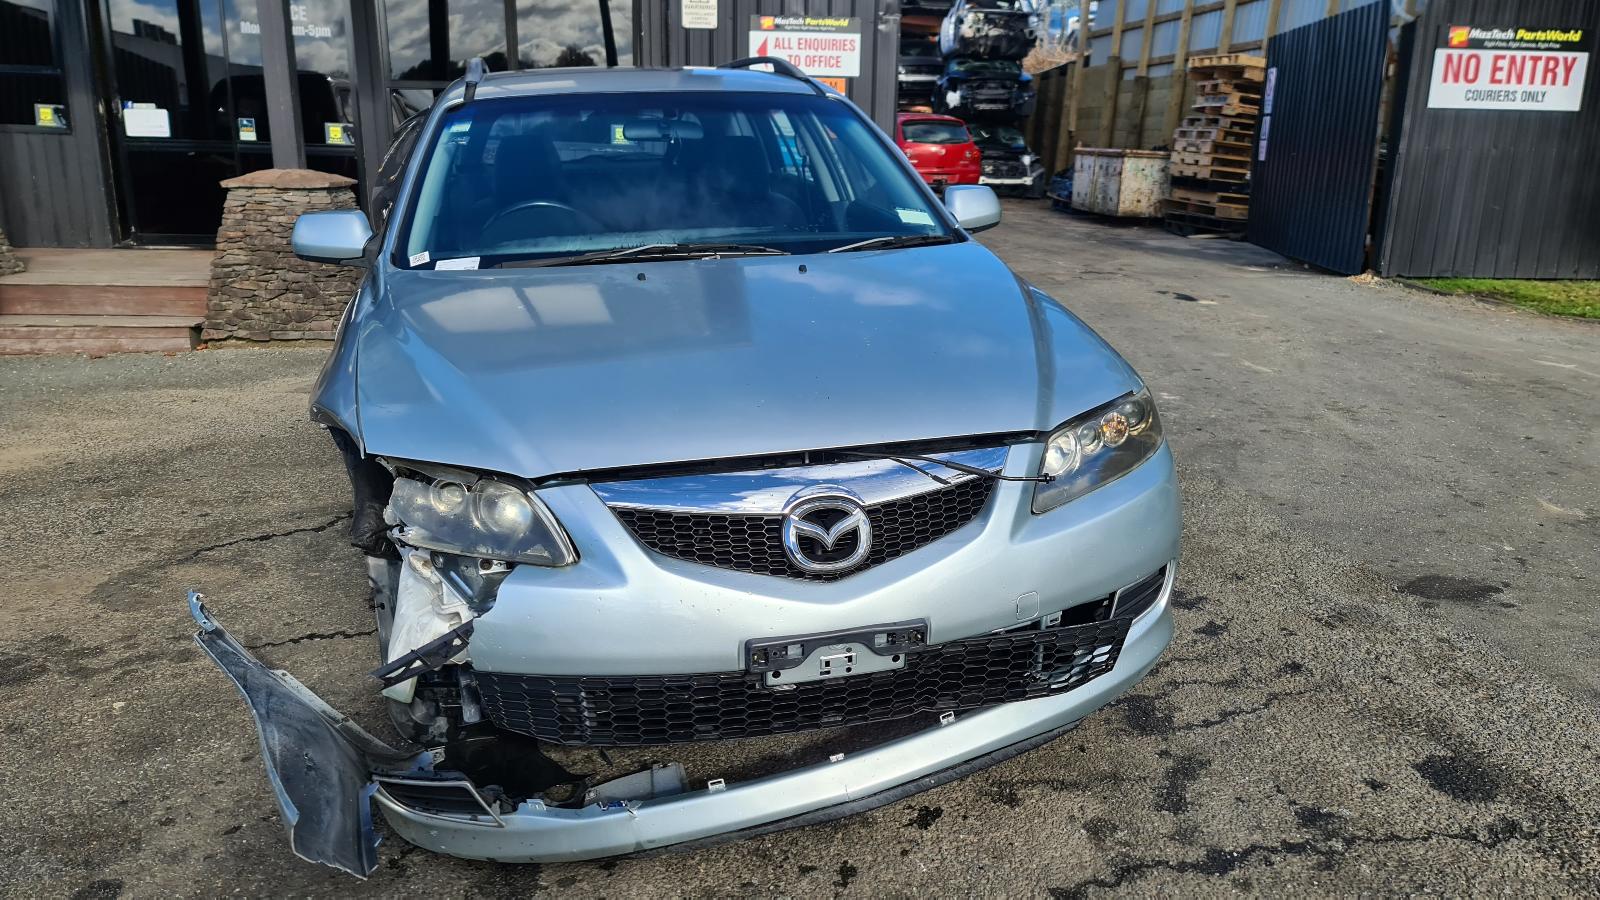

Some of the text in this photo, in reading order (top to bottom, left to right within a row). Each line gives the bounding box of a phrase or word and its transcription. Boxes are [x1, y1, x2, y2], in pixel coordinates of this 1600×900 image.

[1515, 28, 1583, 42] PartsWorld
[774, 37, 856, 51] ALL ENQUIRIES
[788, 55, 842, 68] TO OFFICE
[1442, 53, 1578, 86] NO ENTRY
[1464, 89, 1547, 103] COURIERS ONLY
